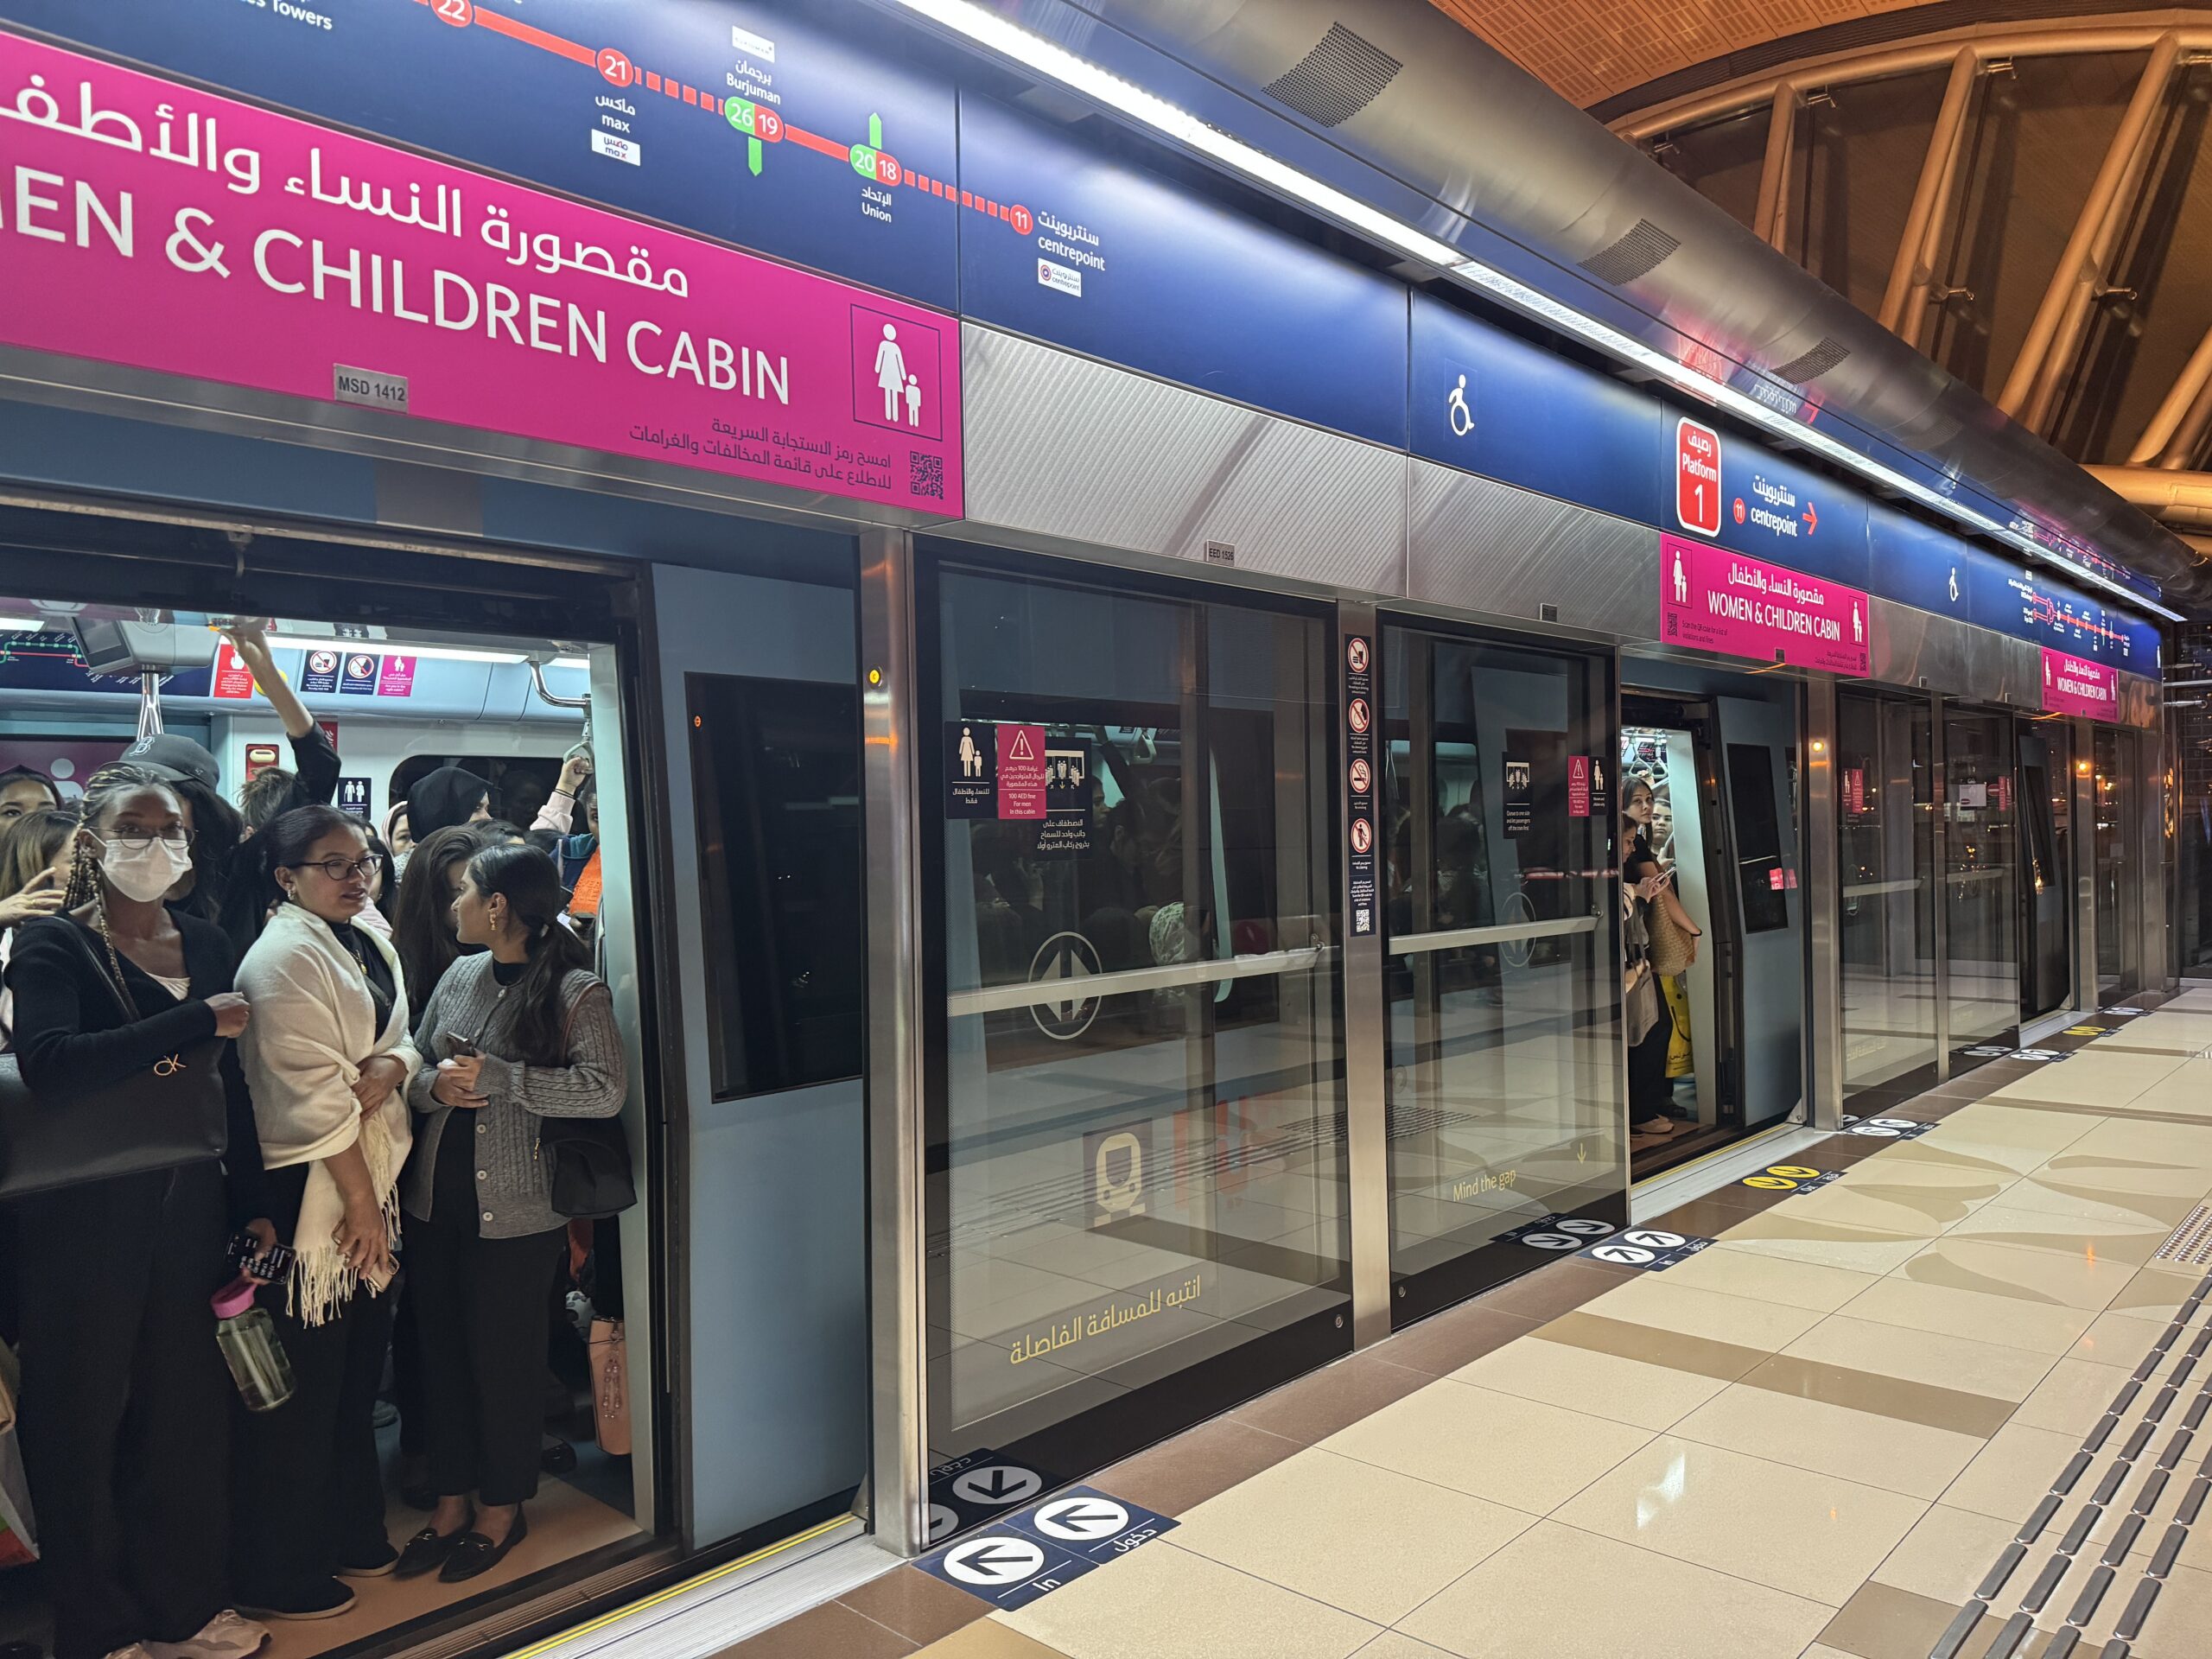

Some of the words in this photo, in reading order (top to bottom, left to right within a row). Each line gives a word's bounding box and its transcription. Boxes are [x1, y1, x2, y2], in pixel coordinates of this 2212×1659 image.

[604, 55, 626, 80] 21
[735, 59, 772, 86] برجمان
[727, 72, 781, 105] Burjuman
[594, 95, 636, 116] ماكس
[730, 103, 753, 127] 26
[0, 74, 260, 195] والأطف
[602, 114, 631, 133] max
[758, 114, 778, 134] 19
[605, 147, 627, 159] max
[855, 149, 874, 173] 20
[879, 159, 897, 180] 18
[284, 147, 462, 237] النساء
[861, 201, 893, 224] Union
[1014, 211, 1027, 230] 11
[1038, 210, 1099, 246] سنتربوينت
[480, 204, 689, 298] مقصورة
[1038, 235, 1106, 271] centrepoint
[0, 164, 134, 258] EN
[164, 207, 232, 278] &
[253, 228, 607, 364] CHILDREN
[626, 320, 789, 406] CABIN
[1052, 276, 1079, 290] centrepoint
[338, 375, 370, 397] MSD
[373, 379, 406, 403] 1412
[629, 424, 699, 455] والغرامات
[712, 417, 768, 443] السريعة
[702, 439, 770, 467] المخالفات
[773, 431, 832, 457] الاستجابة
[835, 446, 854, 463] رمز
[1688, 430, 1712, 457] رصيف
[774, 454, 811, 474] قائمة
[815, 463, 843, 481] على
[1681, 452, 1717, 482] Platform
[847, 468, 892, 490] للاطلاع
[1752, 474, 1796, 507] سنتربوينت
[1694, 484, 1703, 524] 1
[1735, 503, 1744, 518] 11
[1751, 506, 1798, 537] centrepoint
[1209, 548, 1220, 558] EED
[1728, 562, 1767, 595] والأطفال
[1768, 573, 1792, 598] النساء
[1793, 582, 1824, 606] مقصورة
[1707, 589, 1753, 623] WOMEN
[1755, 602, 1763, 624] &
[1764, 605, 1812, 636] CHILDREN
[1814, 616, 1840, 642] CABIN
[2057, 677, 2074, 694] WOMEN
[2077, 681, 2096, 699] CHILDREN
[2096, 686, 2107, 701] CABIN
[1452, 1176, 1478, 1203] Mind
[1481, 1173, 1497, 1192] the
[1499, 1169, 1516, 1192] gap
[1166, 1274, 1201, 1308] انتبه
[1086, 1288, 1161, 1338] للمسافة
[1009, 1316, 1082, 1365] الفاصلة
[1113, 1528, 1158, 1554] دخول
[1033, 1576, 1061, 1592] In
